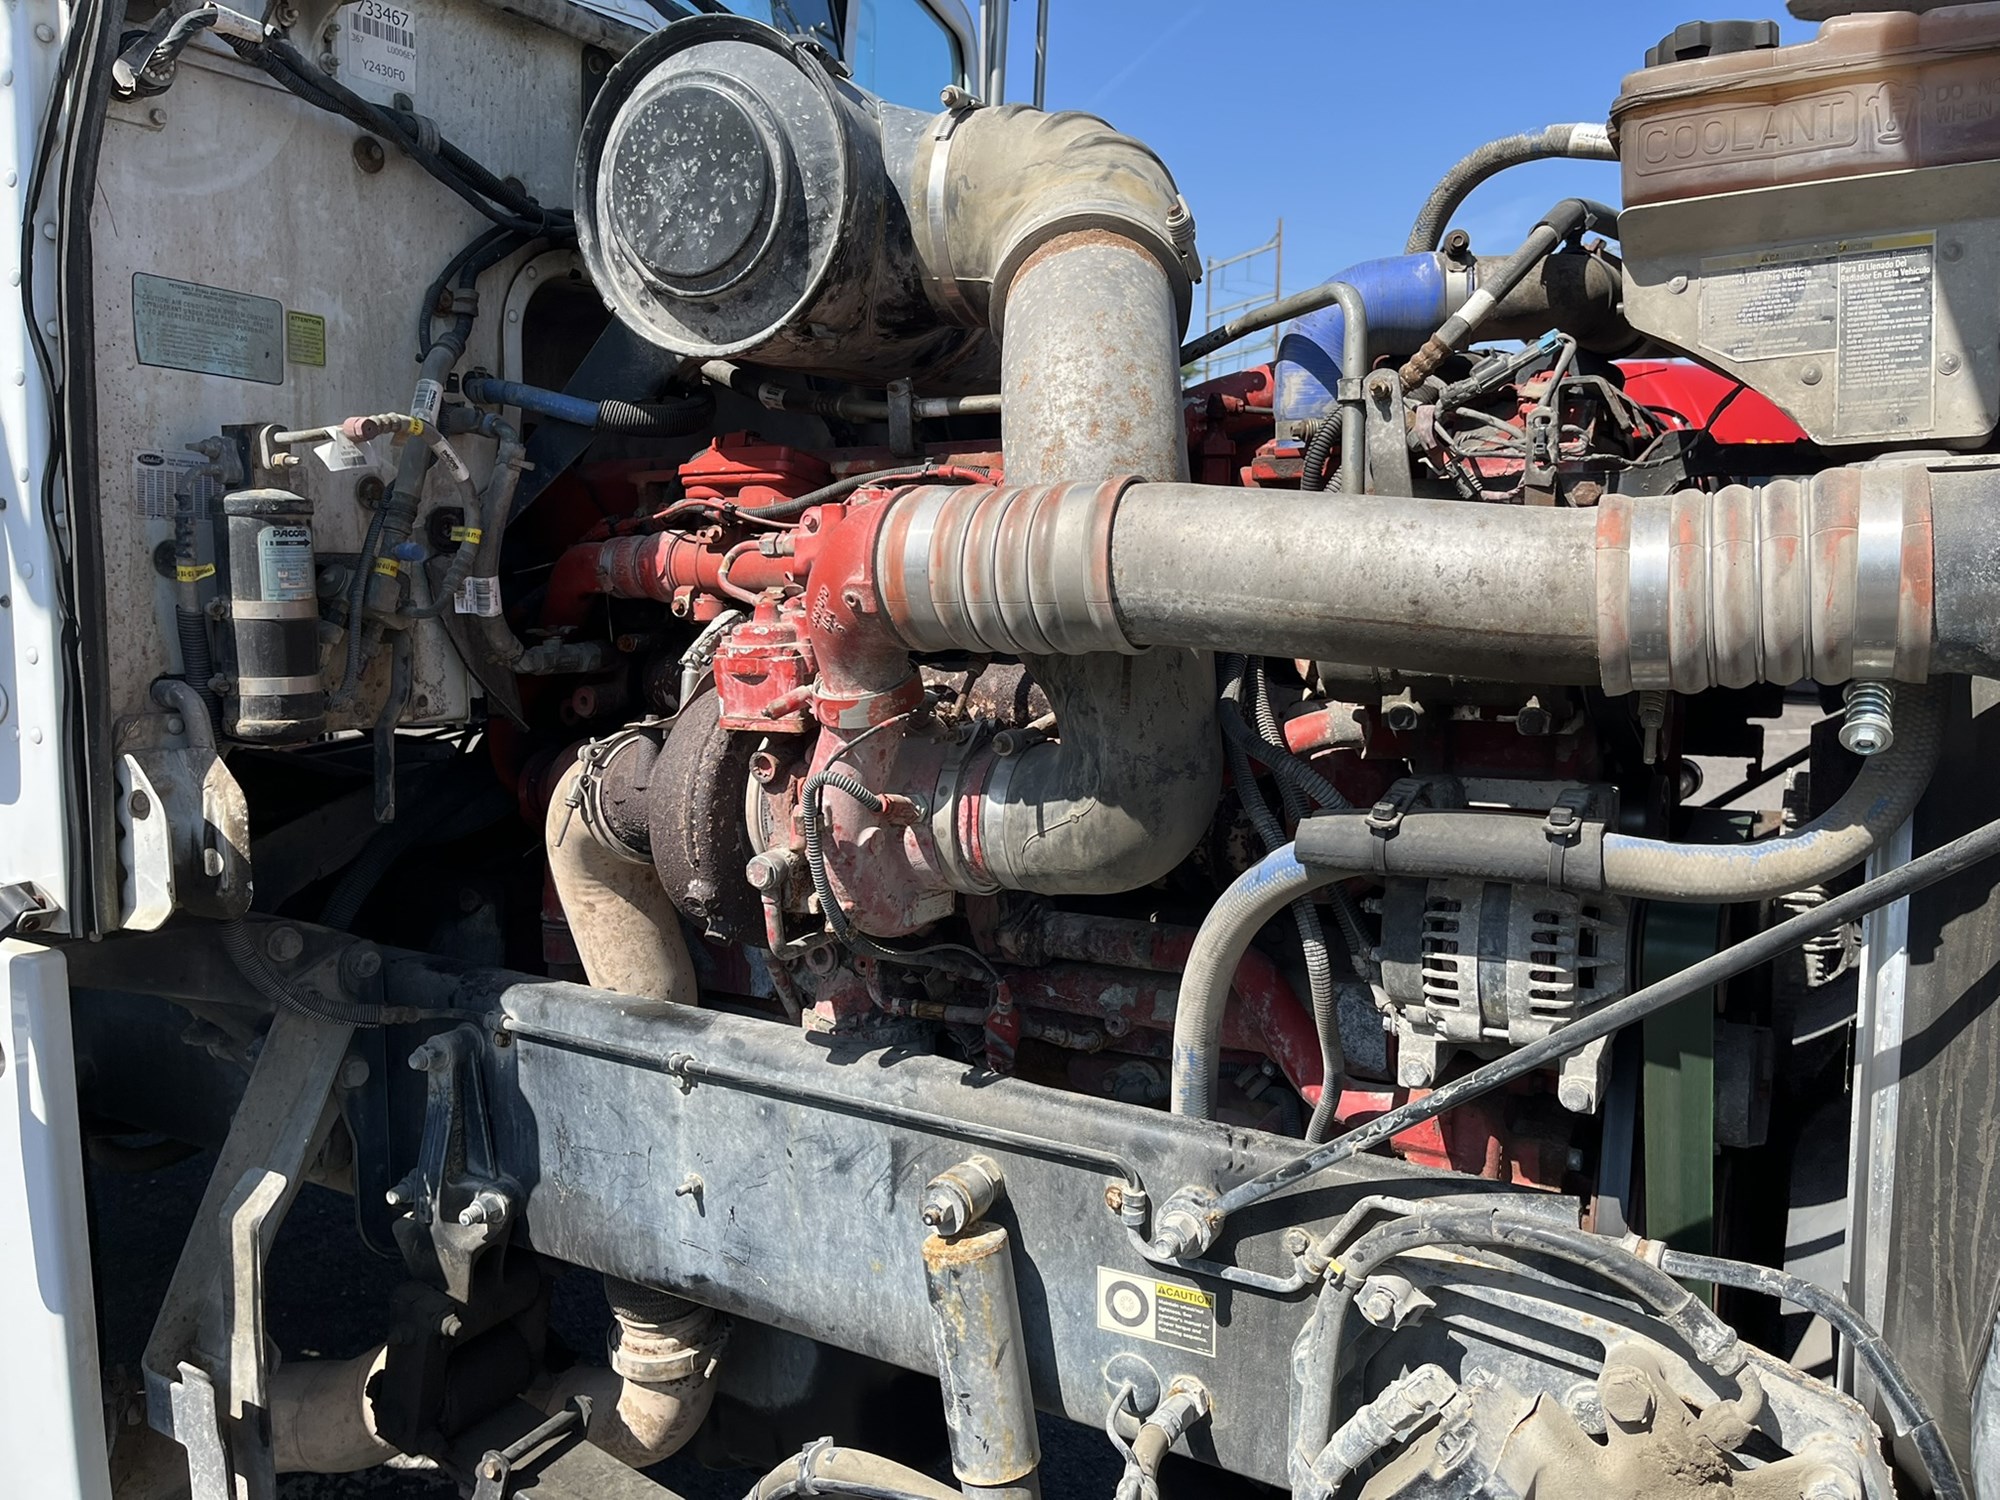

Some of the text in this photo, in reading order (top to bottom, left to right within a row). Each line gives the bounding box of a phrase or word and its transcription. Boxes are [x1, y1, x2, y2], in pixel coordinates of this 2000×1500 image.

[1936, 100, 1992, 123] WHEN
[1645, 101, 1844, 164] COOLANT
[1841, 265, 1856, 274] Para
[1866, 260, 1893, 271] Llenado
[1896, 257, 1907, 267] Del
[1747, 275, 1761, 284] For
[1764, 273, 1779, 282] This
[1782, 268, 1811, 280] Vehicle
[1841, 272, 1871, 283] Radiador
[1873, 271, 1882, 279] En
[1884, 268, 1899, 278] Este
[273, 530, 307, 538] PACCAR
[1166, 1288, 1212, 1307] CAUTION
